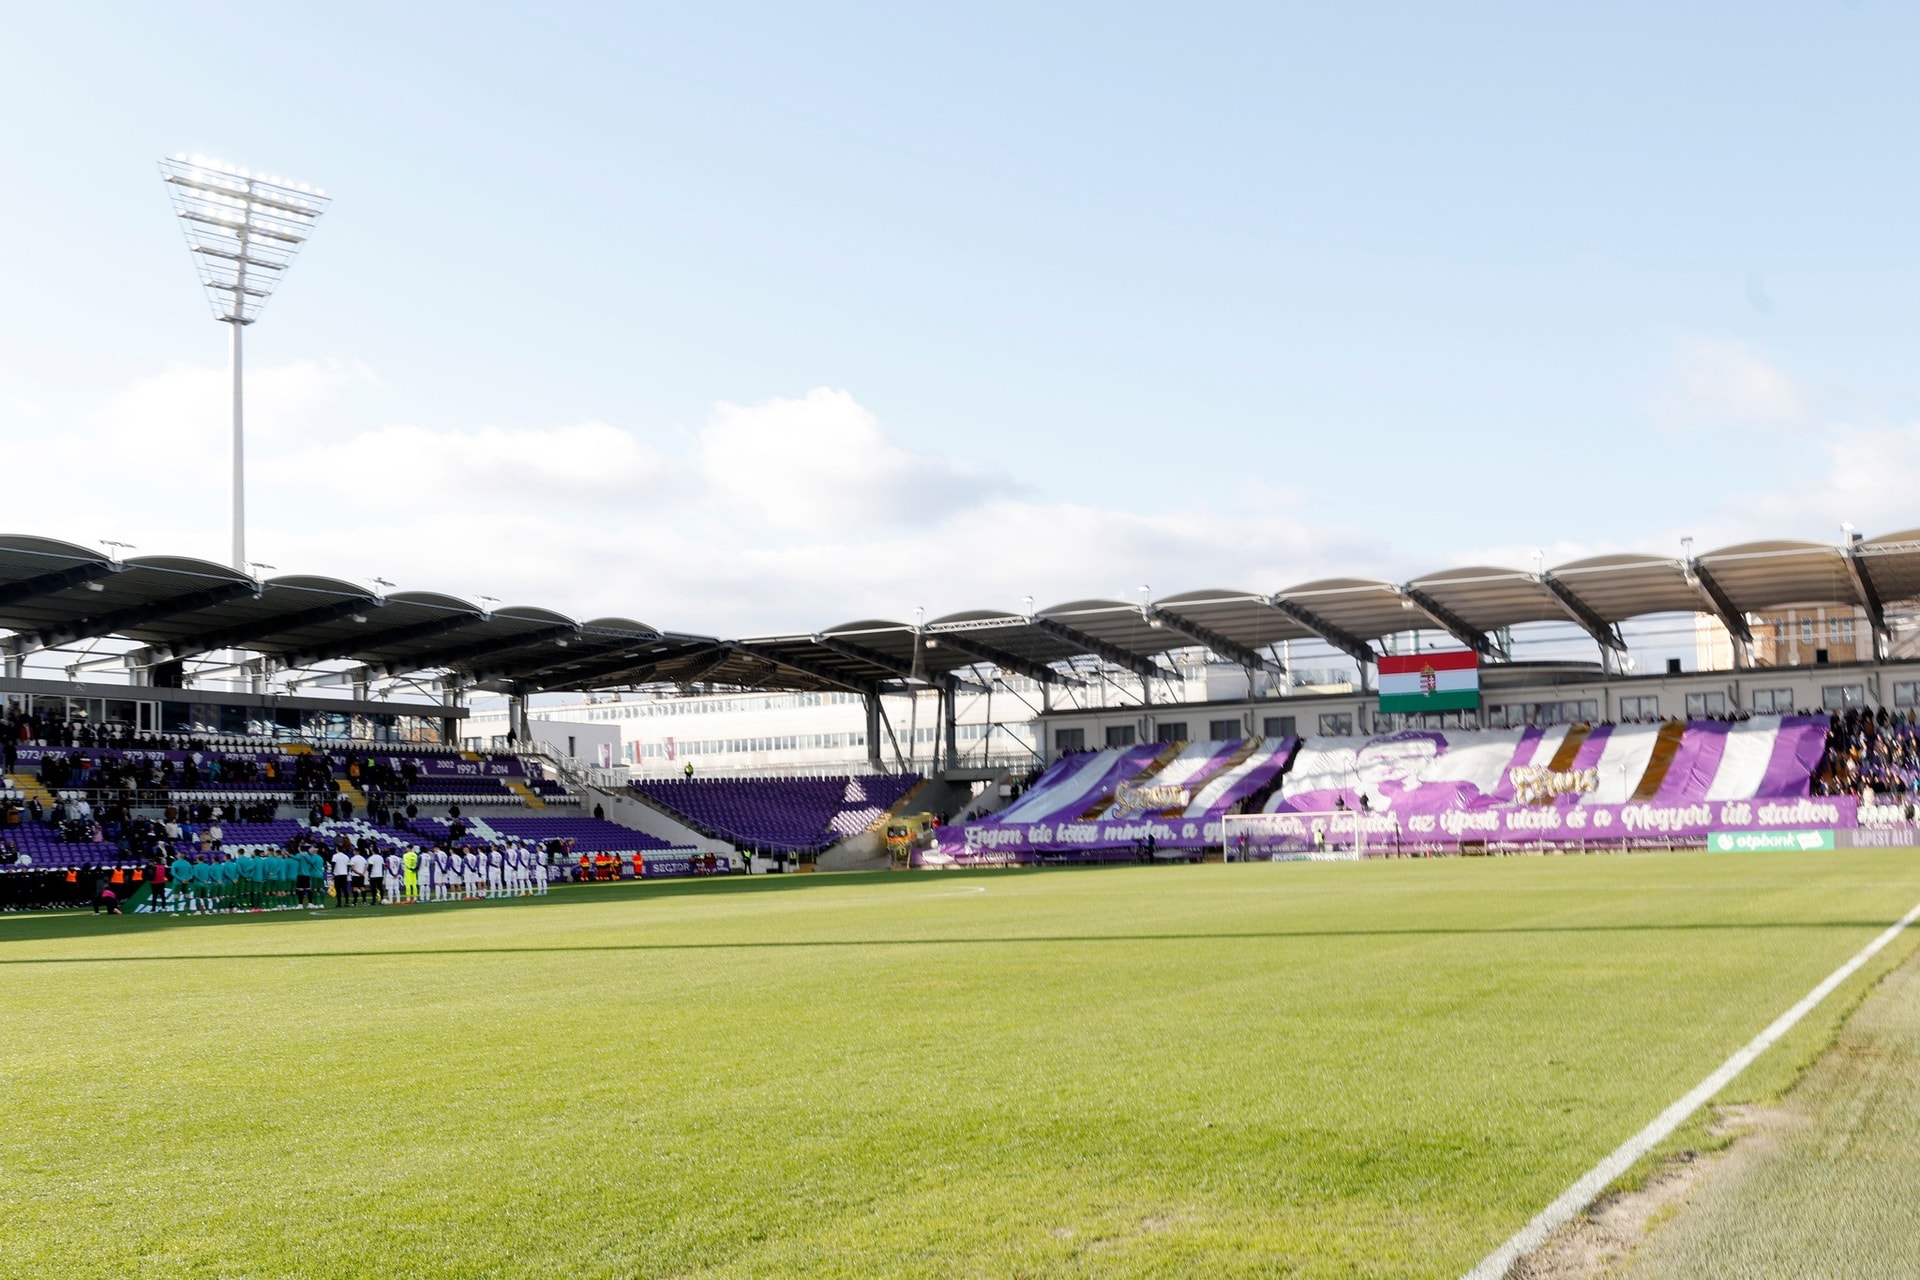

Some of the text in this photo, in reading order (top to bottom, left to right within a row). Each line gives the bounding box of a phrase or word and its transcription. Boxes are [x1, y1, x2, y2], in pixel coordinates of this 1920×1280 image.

[457, 764, 478, 774] 1992
[964, 826, 1022, 849] Engem
[1182, 823, 1198, 838] a
[1757, 798, 1839, 826] stadion
[1736, 832, 1795, 850] otpbank
[652, 864, 690, 875] SECTOR
